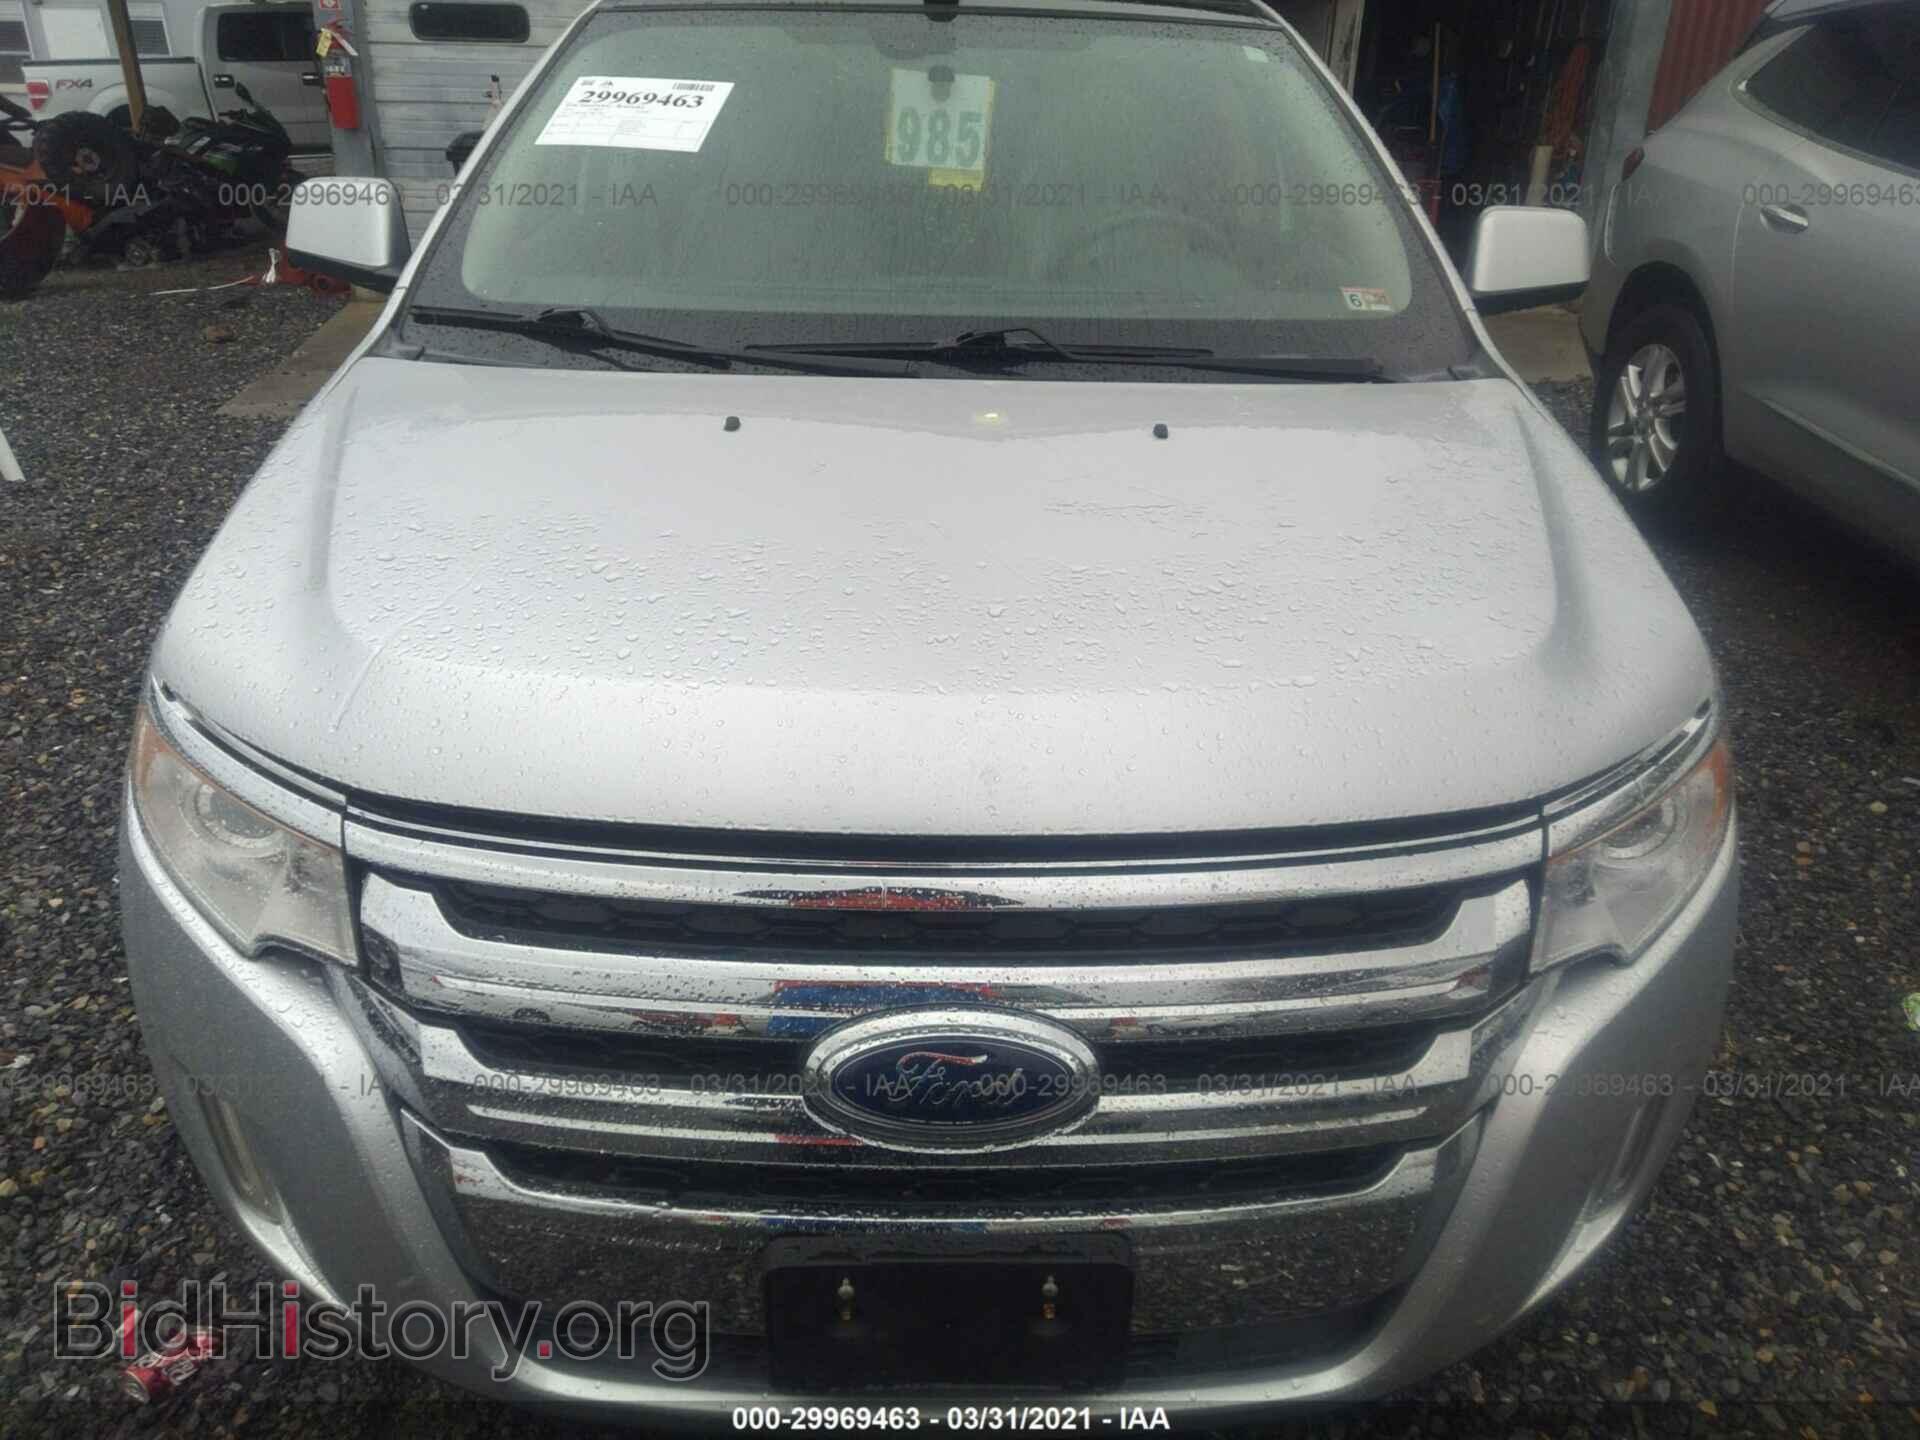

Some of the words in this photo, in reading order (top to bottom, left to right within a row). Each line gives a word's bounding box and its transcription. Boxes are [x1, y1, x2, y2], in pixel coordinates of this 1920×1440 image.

[56, 78, 94, 90] FX4
[578, 90, 705, 109] 29969463
[896, 106, 984, 169] 985
[889, 1051, 1024, 1106] Ford
